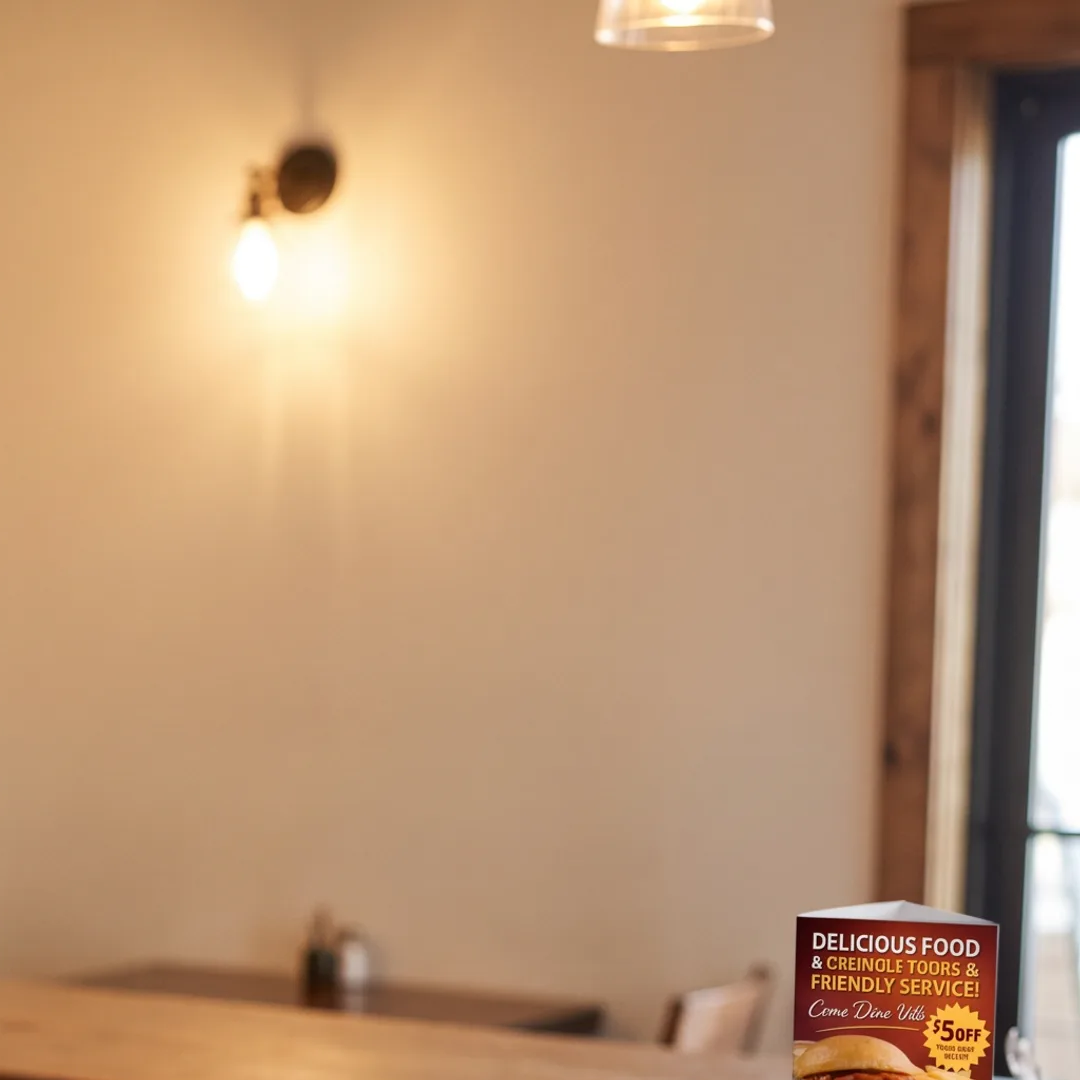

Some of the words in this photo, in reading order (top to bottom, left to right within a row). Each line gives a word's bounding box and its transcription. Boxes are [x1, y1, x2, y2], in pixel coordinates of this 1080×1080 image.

[812, 932, 916, 955] DELICIOUS
[922, 937, 981, 958] FOOD
[811, 955, 823, 970] &
[811, 974, 895, 994] FRIENDLY
[899, 978, 980, 998] SERVICE!
